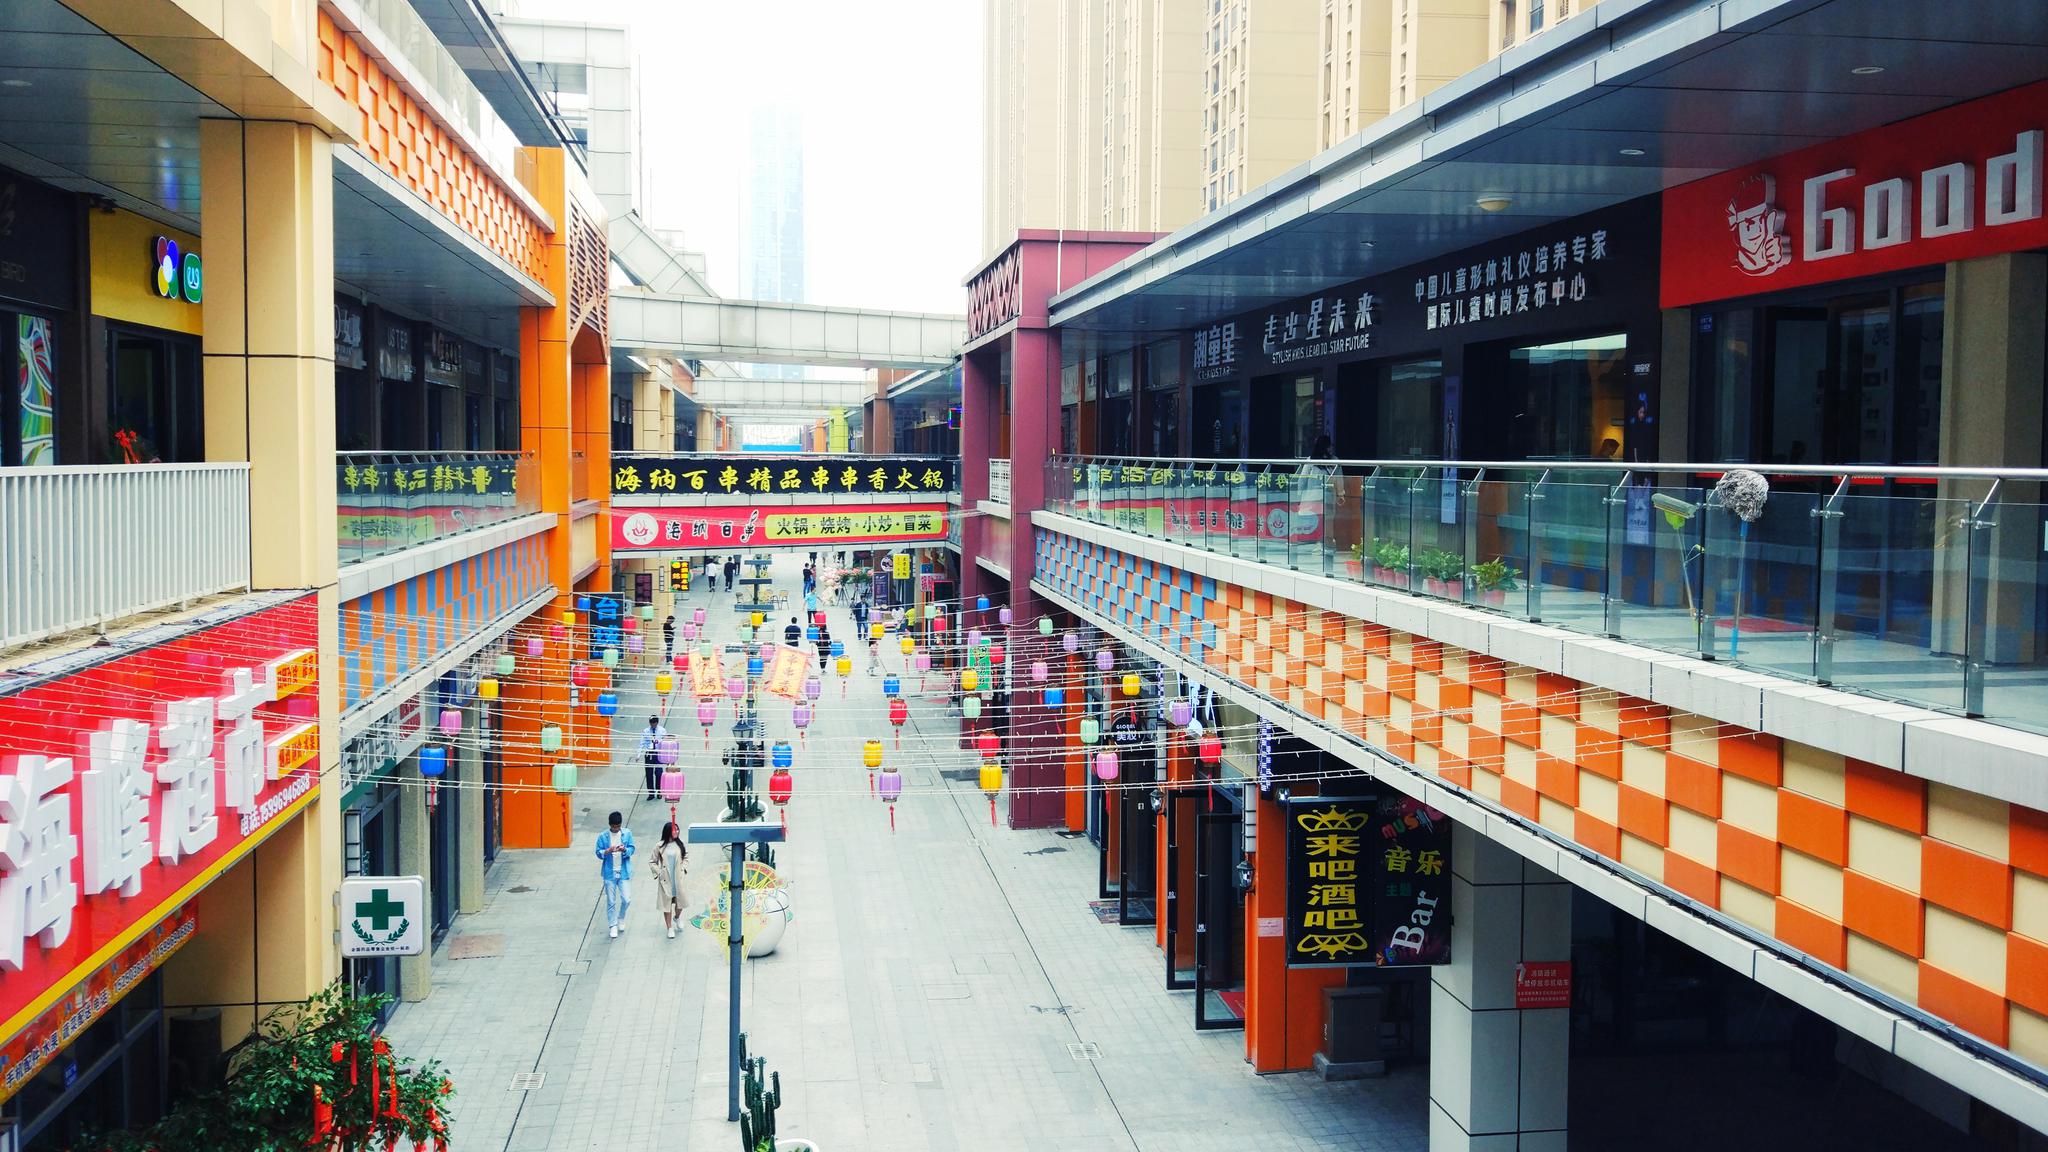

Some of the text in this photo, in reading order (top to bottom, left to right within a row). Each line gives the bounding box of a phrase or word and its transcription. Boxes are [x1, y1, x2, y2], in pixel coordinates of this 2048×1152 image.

[1803, 129, 2044, 262] Good
[1415, 229, 1608, 303] 中国儿童形体礼仪培养专家
[1263, 291, 1374, 354] 走出星未来
[1427, 271, 1587, 331] 国际儿童时尚发布中心
[1193, 322, 1236, 369] 潮童星
[1330, 338, 1344, 353] STAR
[1345, 333, 1370, 352] FUTURE
[614, 465, 944, 493] 海纳百串精品串串香火锅
[665, 509, 759, 543] 海纳百串
[1303, 834, 1364, 930] 来吧酒吧
[1385, 845, 1444, 876] 音乐
[1390, 889, 1439, 955] Bar
